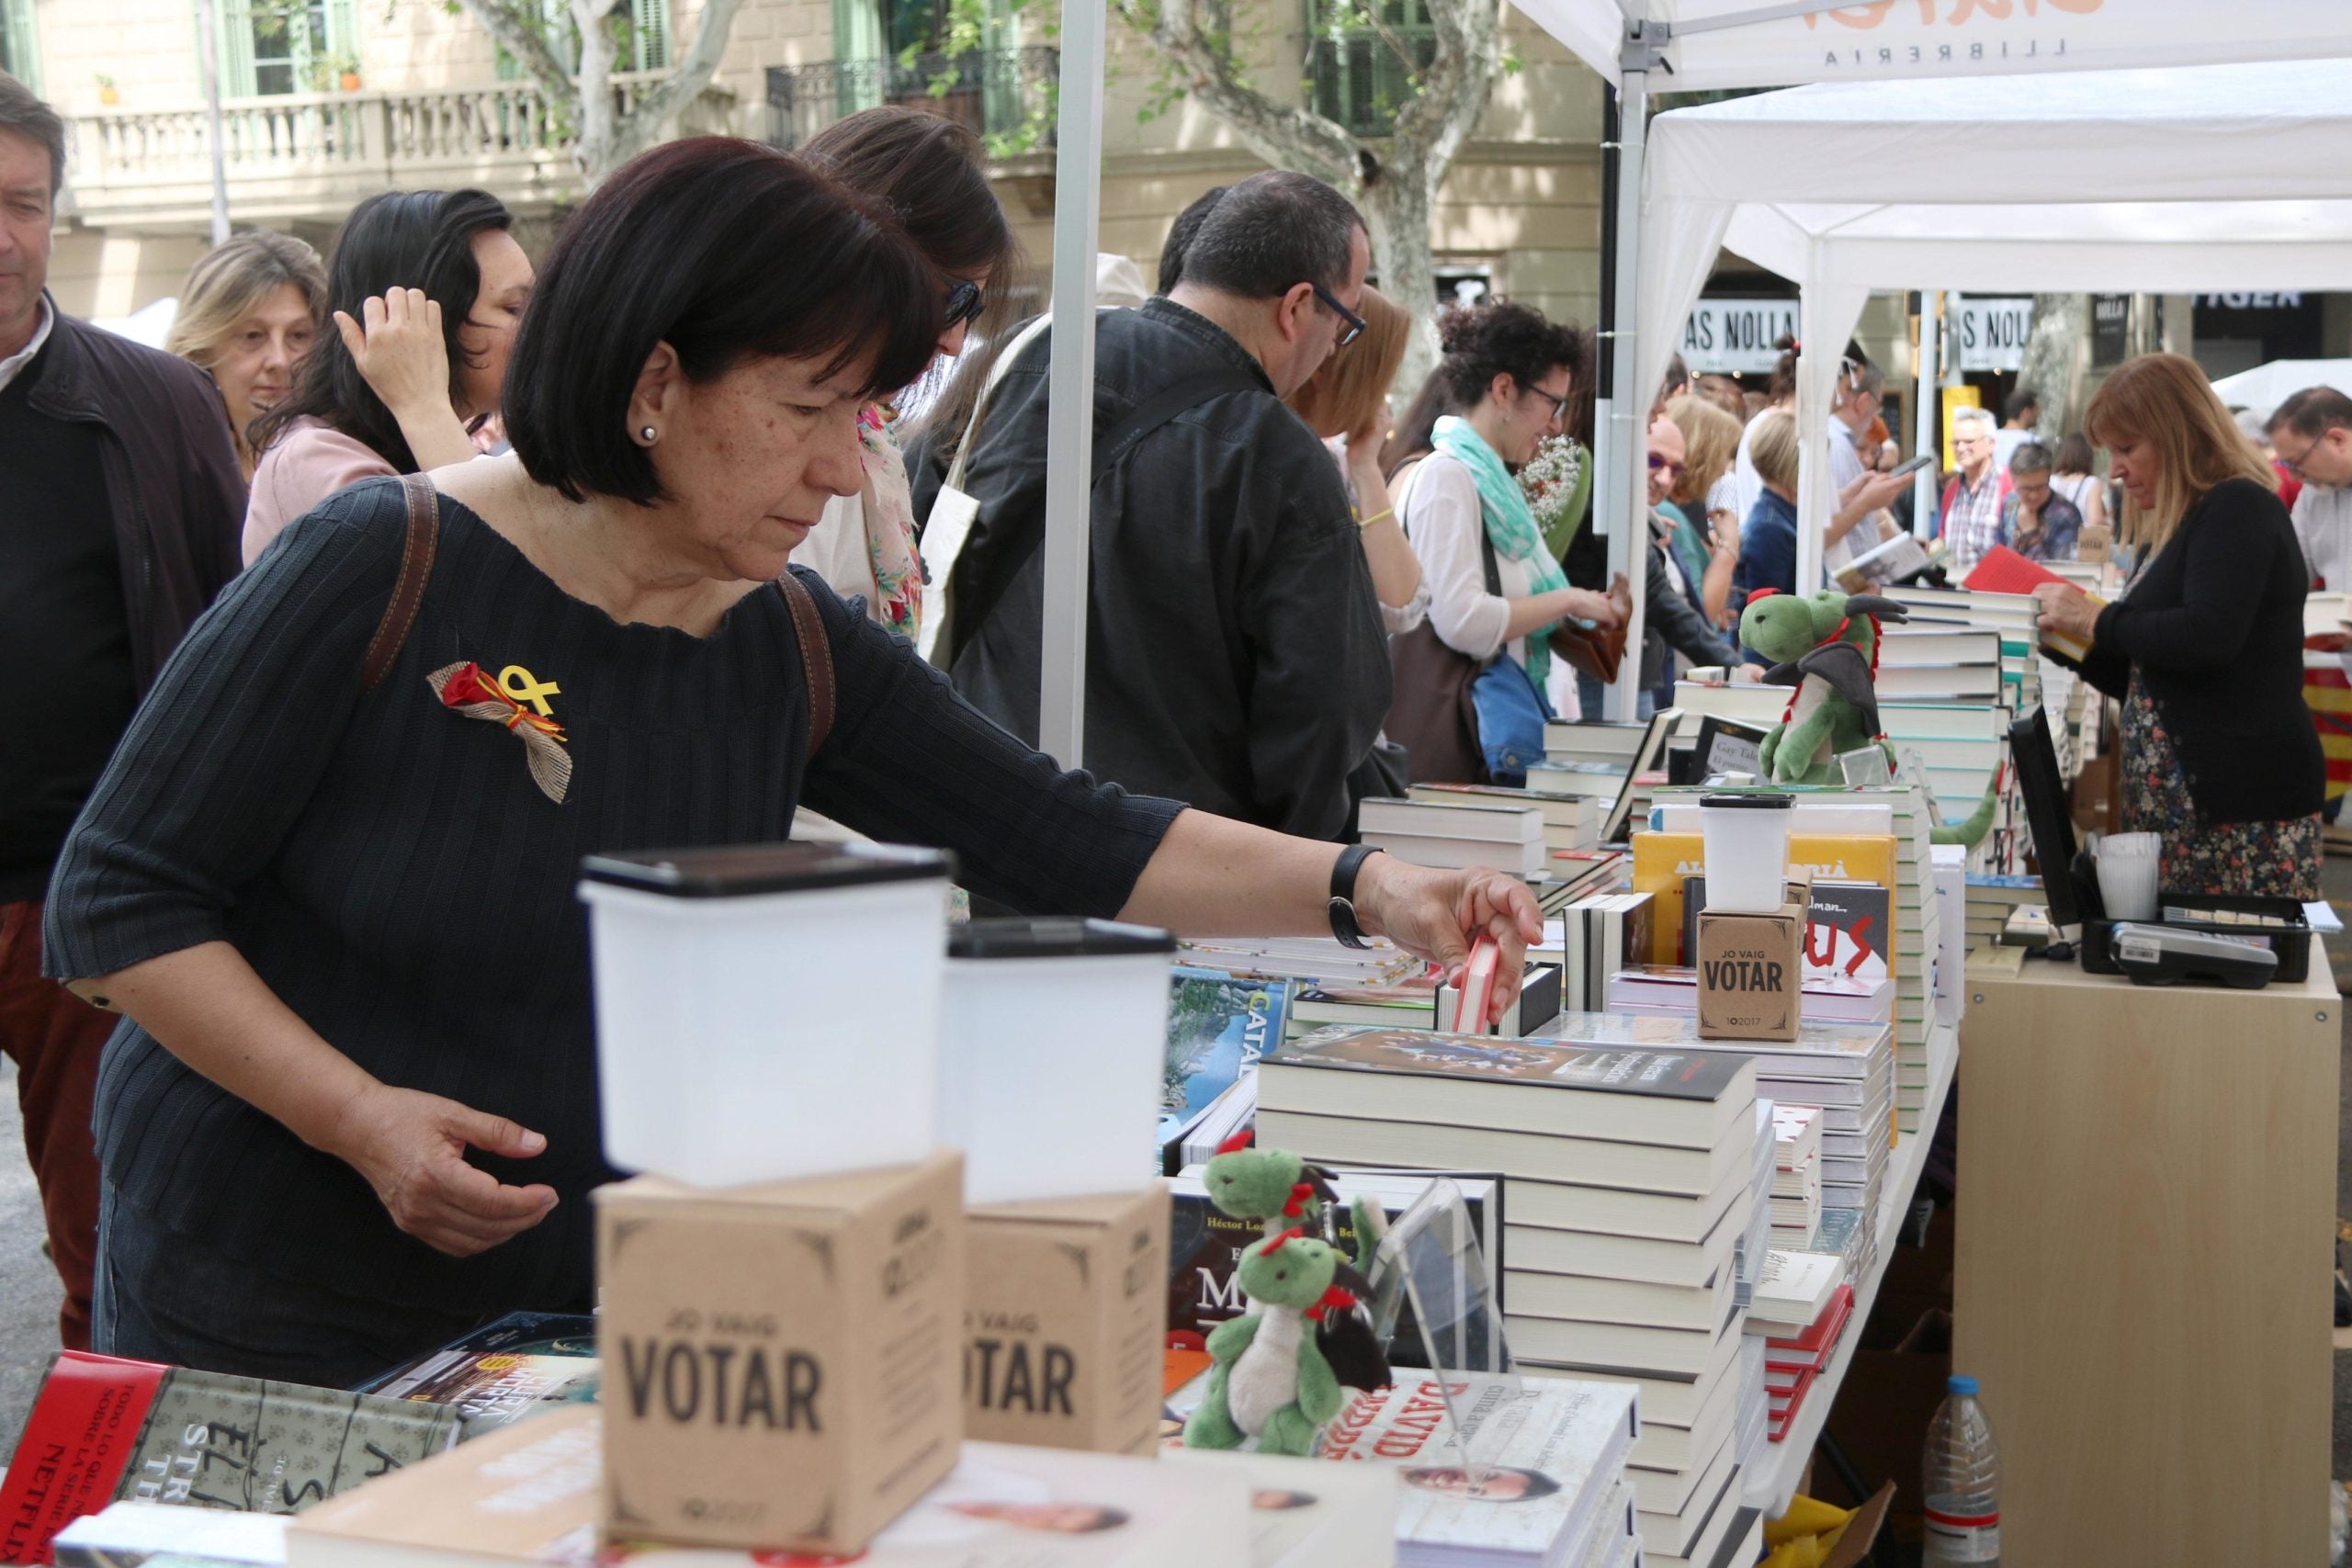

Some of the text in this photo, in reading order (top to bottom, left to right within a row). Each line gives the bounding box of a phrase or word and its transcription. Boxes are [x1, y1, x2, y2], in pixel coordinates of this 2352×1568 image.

[1716, 740, 1736, 757] Gay
[1721, 950, 1765, 959] JO VAIG
[1703, 961, 1782, 992] VOTAR
[1206, 1217, 1243, 1229] Héctor
[978, 1311, 1039, 1333] VAIG
[621, 1334, 825, 1433] VOTAR
[964, 1337, 1077, 1416] TAR
[83, 1386, 117, 1443] SOBRE
[107, 1382, 136, 1427] TODO
[1373, 1381, 1470, 1458] DAVID
[73, 1446, 90, 1469] LA
[96, 1431, 114, 1457] LO
[79, 1460, 103, 1495] QUE
[1, 1441, 67, 1564] NETFLIX
[51, 1472, 80, 1522] SERIE
